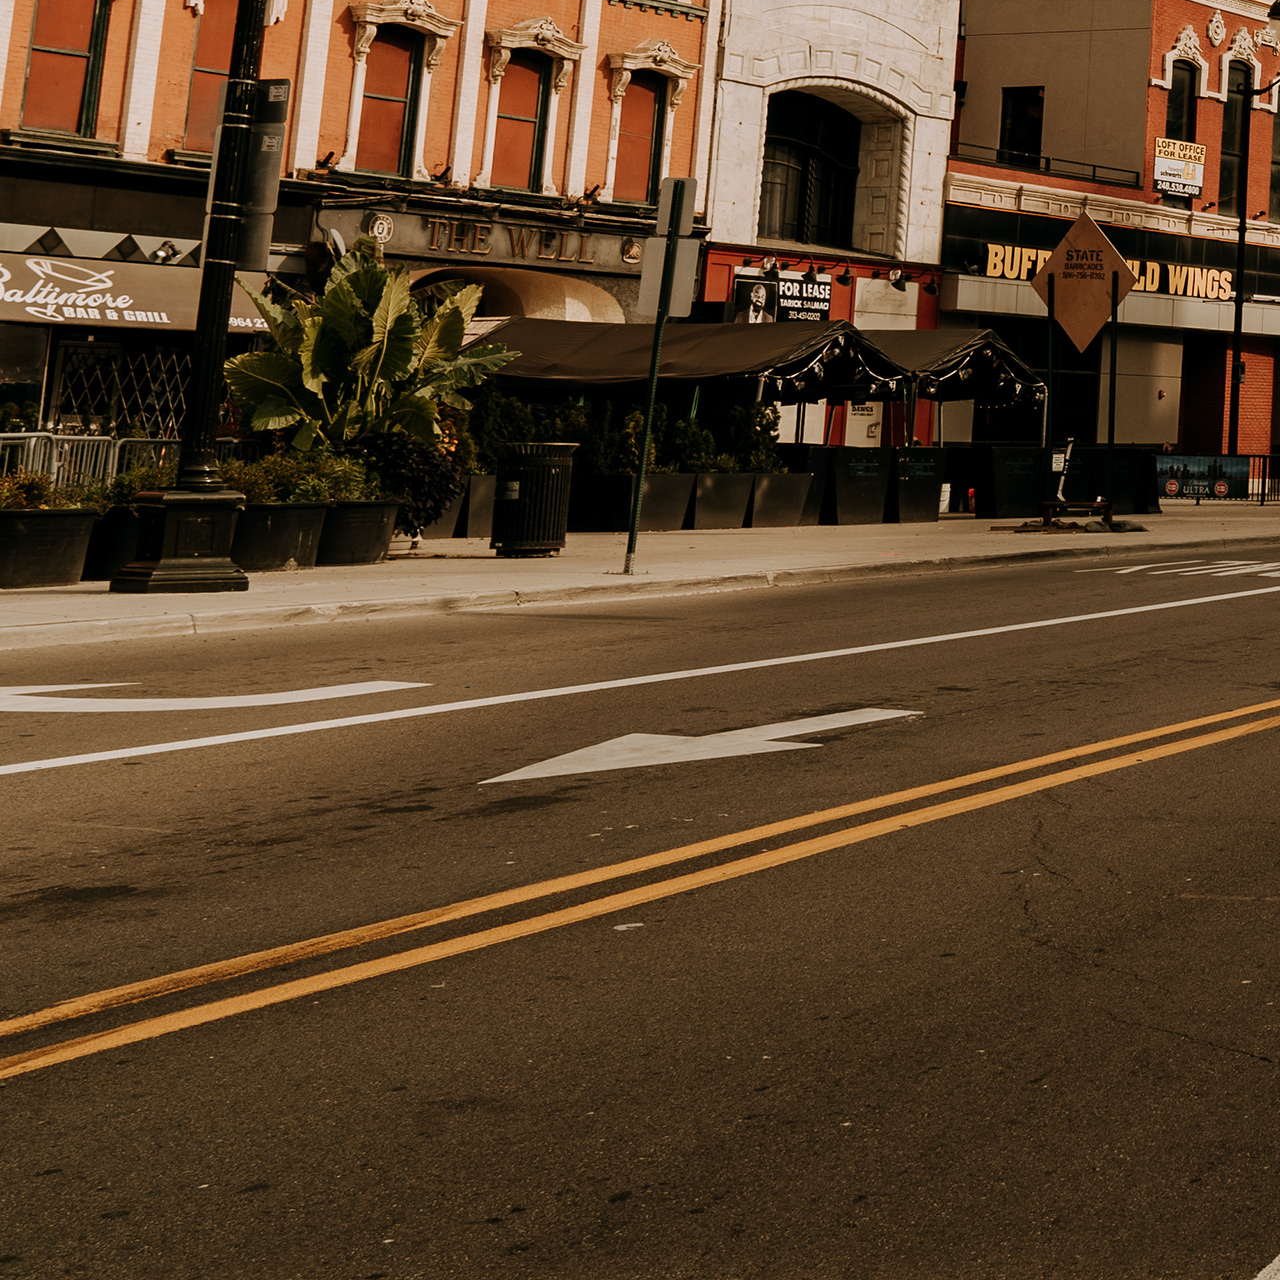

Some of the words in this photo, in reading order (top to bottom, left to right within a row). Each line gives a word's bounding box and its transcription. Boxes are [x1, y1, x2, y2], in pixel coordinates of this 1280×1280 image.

[1156, 139, 1178, 151] LOFT
[1178, 142, 1206, 157] OFFICE
[1158, 148, 1176, 158] FOR
[1177, 152, 1204, 163] LEASE
[426, 217, 493, 255] THE
[506, 225, 596, 264] WELL
[1066, 249, 1104, 262] STATE
[1064, 262, 1104, 271] BARRICADES
[1166, 263, 1234, 301] WINGS
[779, 281, 800, 297] FOR
[802, 283, 831, 300] LEASE
[779, 298, 803, 309] TARICK
[62, 306, 101, 320] BAR
[105, 308, 120, 321] &
[121, 310, 172, 324] GRILL
[1183, 485, 1211, 494] ULTRA
